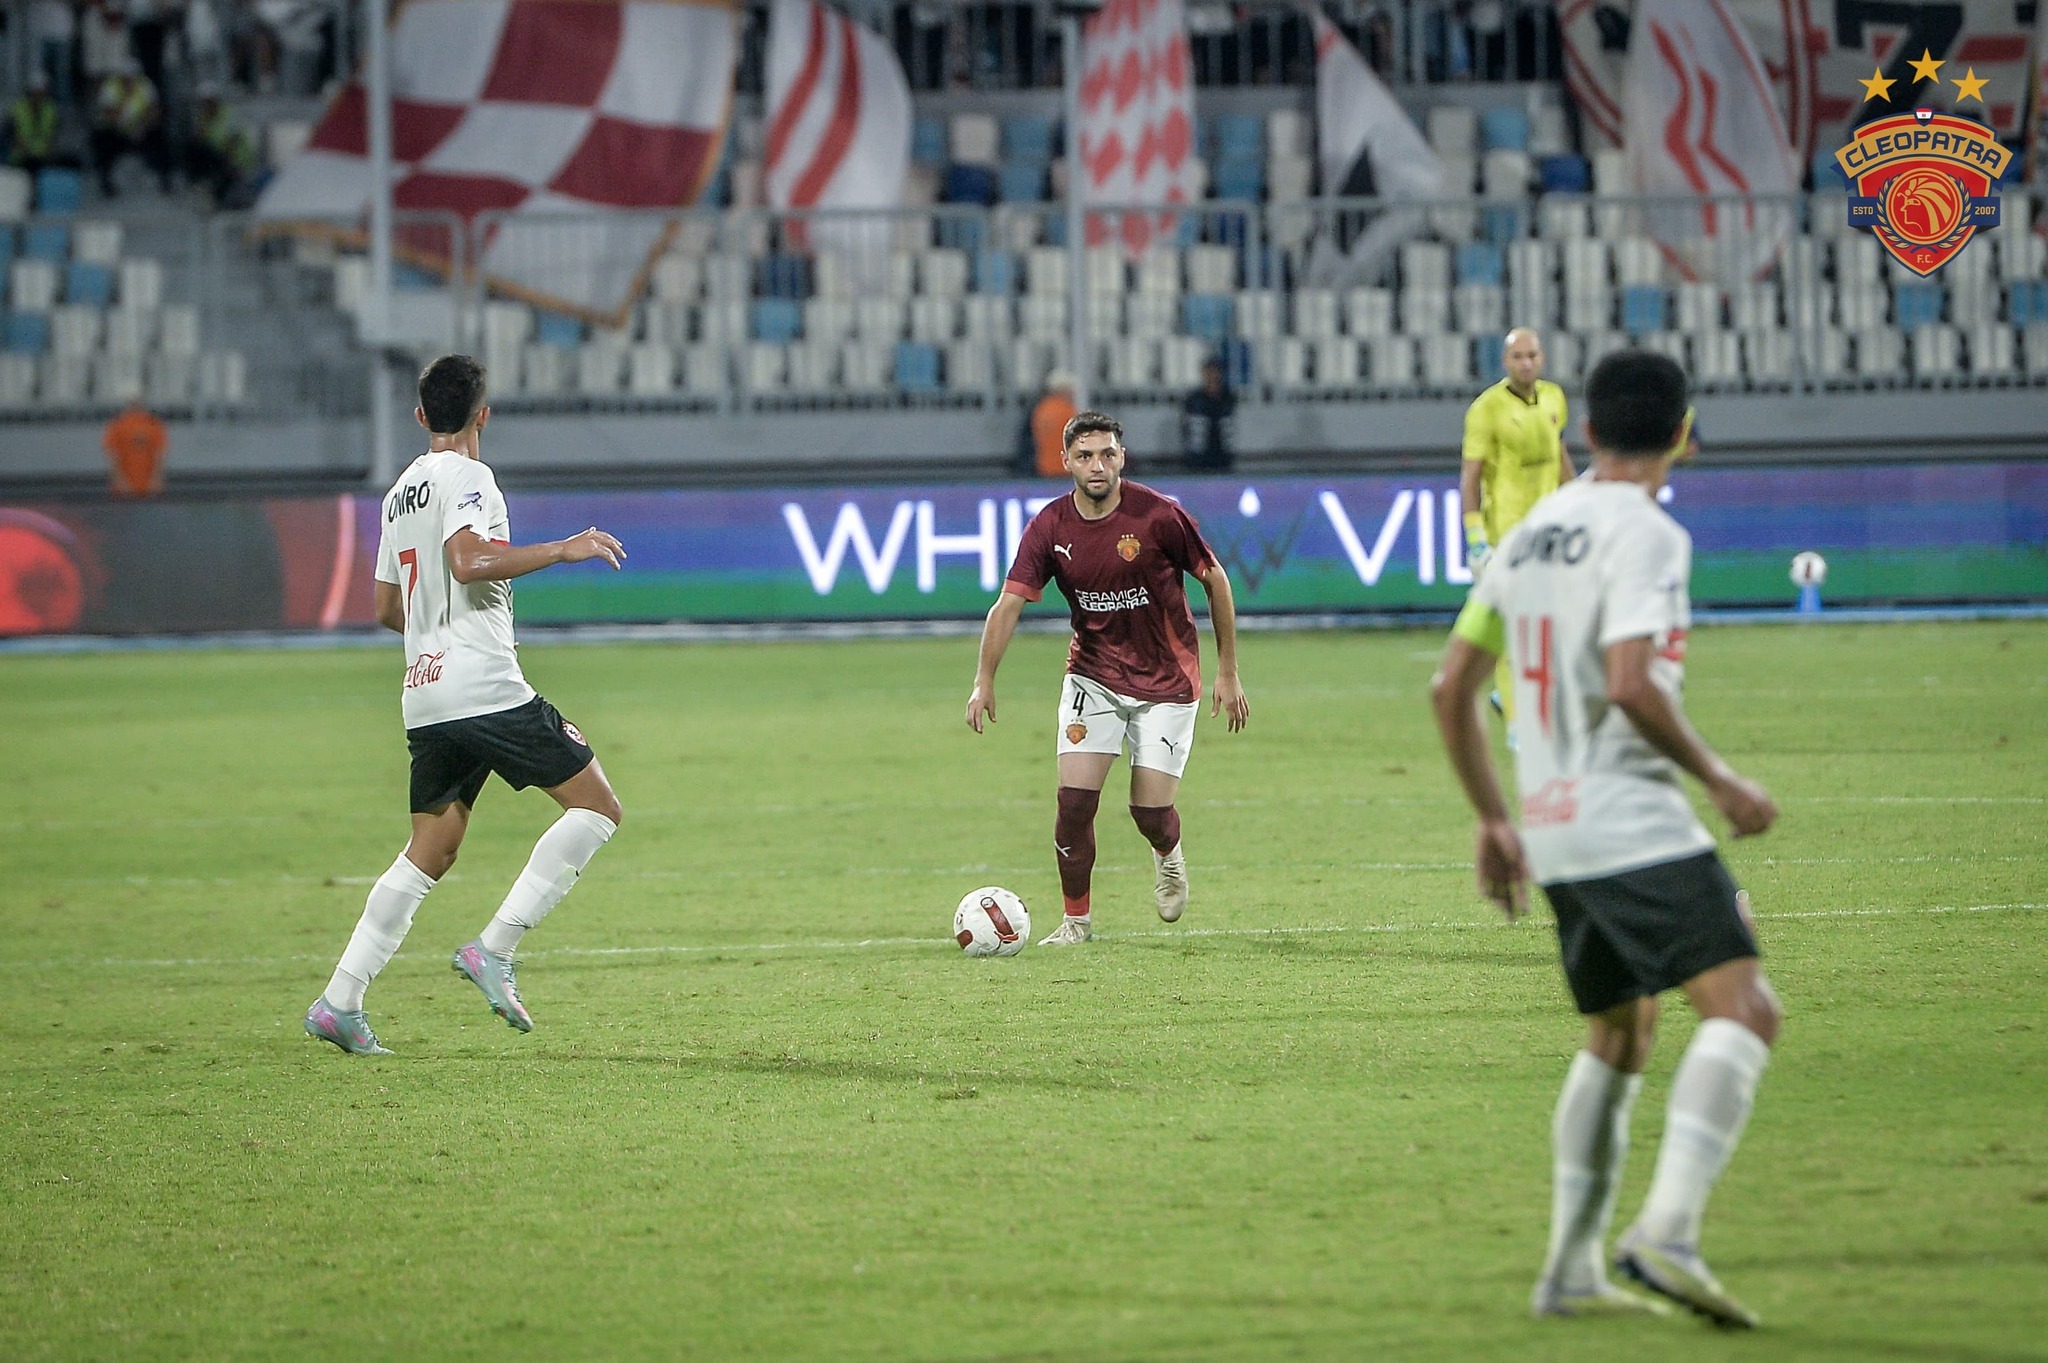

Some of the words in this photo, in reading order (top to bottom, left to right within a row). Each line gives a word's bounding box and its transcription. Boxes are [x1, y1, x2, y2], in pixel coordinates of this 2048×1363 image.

[783, 498, 1060, 595] WHI
[1320, 489, 1474, 585] VIL
[398, 547, 419, 629] 7
[1075, 586, 1148, 602] CERAMICA
[1072, 691, 1086, 717] 4
[1518, 615, 1555, 738] 4
